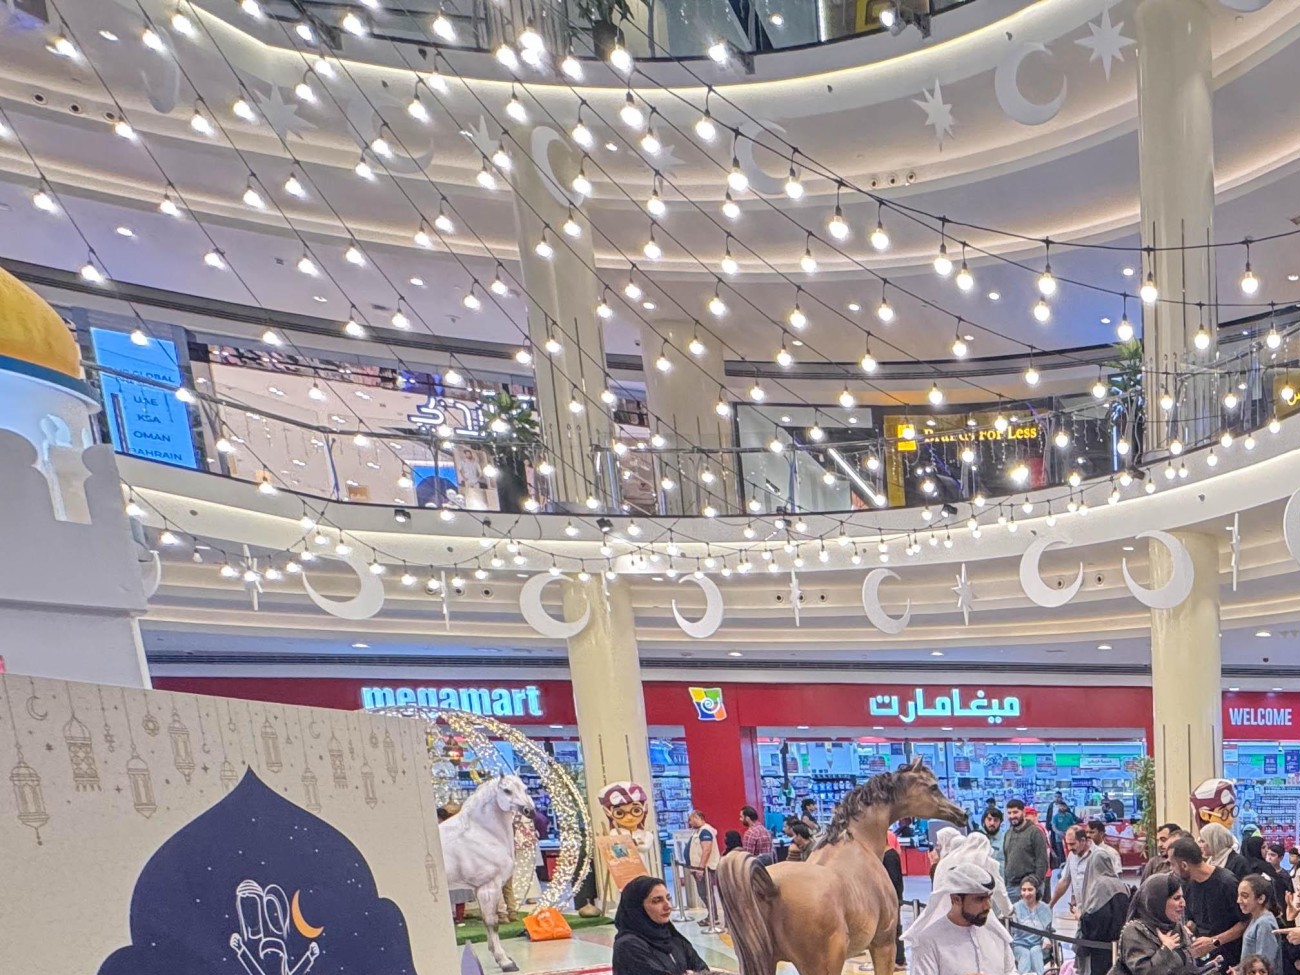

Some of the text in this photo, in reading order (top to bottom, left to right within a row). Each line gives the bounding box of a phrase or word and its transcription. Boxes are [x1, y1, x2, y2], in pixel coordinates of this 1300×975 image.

[133, 430, 171, 443] OMAN
[1007, 425, 1037, 440] Less
[868, 688, 1021, 724] ميغامارت
[1229, 708, 1293, 726] WELCOME
